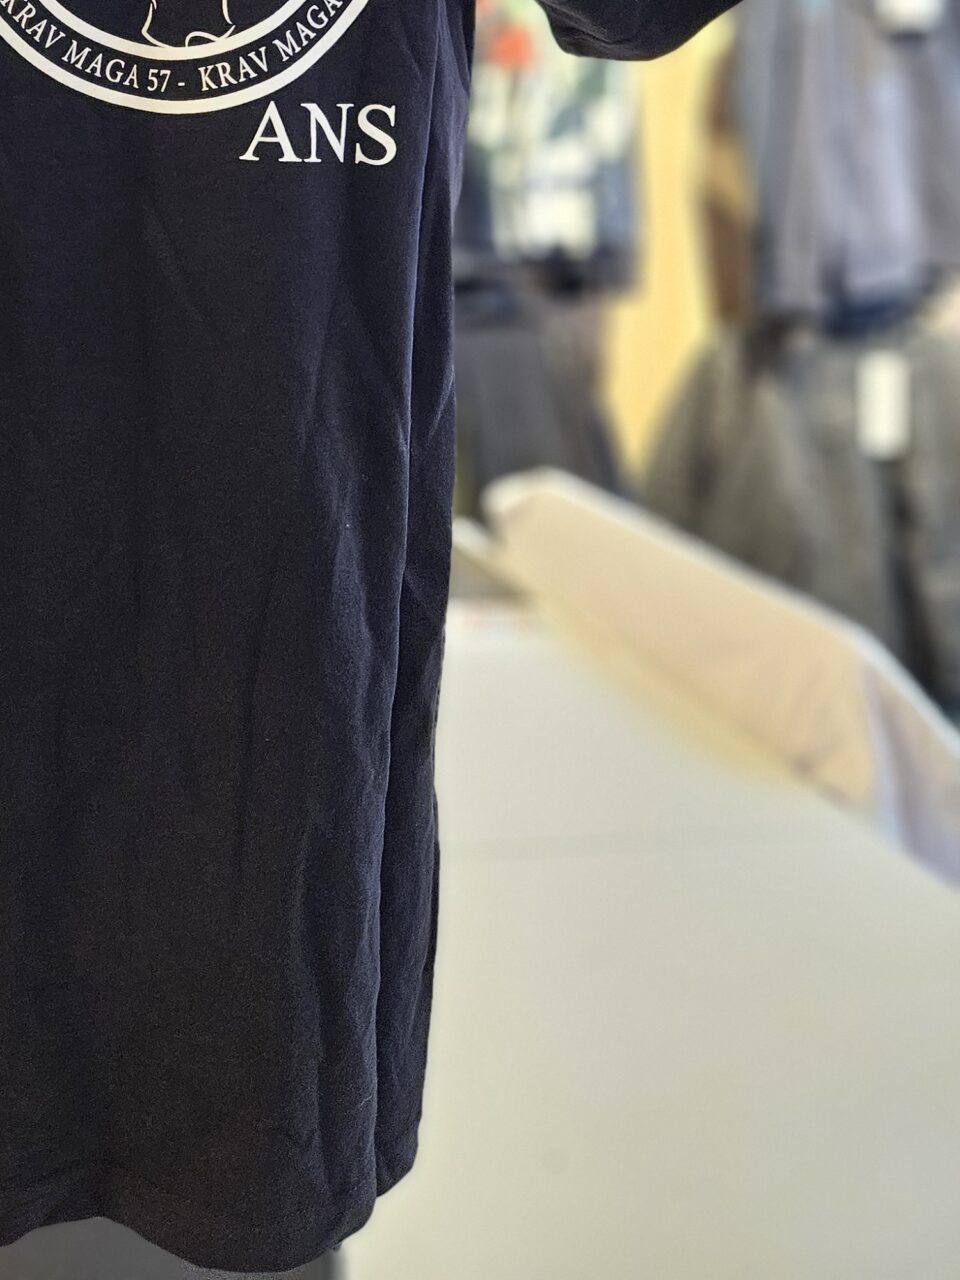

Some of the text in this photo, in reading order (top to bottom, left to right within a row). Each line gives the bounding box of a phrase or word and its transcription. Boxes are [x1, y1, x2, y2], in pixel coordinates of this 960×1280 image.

[62, 40, 138, 88] MAGA
[148, 69, 171, 92] 57
[198, 47, 268, 91] KRAV
[239, 101, 397, 166] ANS
